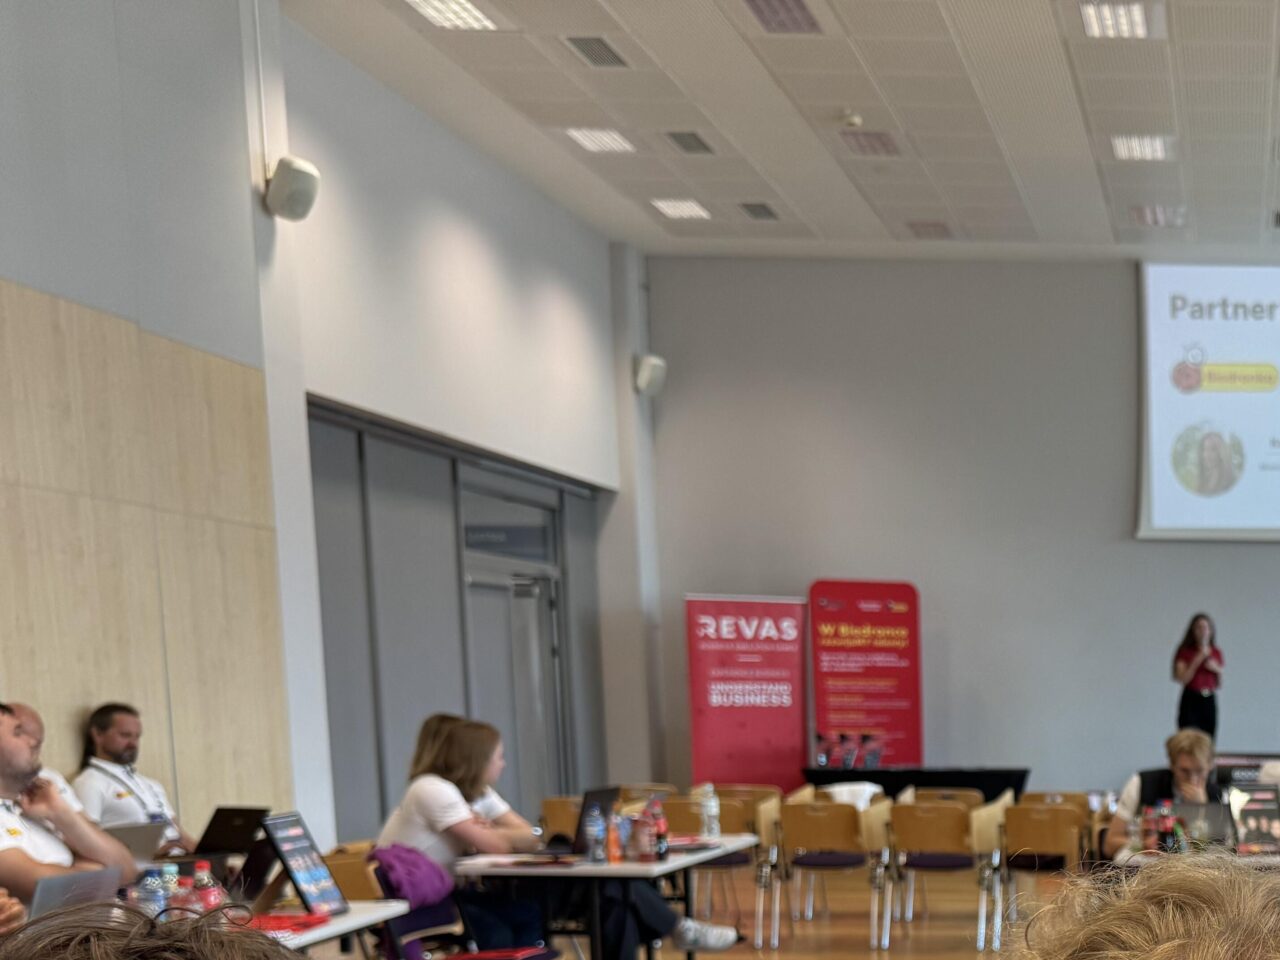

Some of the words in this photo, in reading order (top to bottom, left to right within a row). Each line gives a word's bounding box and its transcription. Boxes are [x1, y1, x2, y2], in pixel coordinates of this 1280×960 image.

[1170, 295, 1278, 321] Partner
[697, 615, 798, 641] REVAS
[709, 693, 793, 707] BUSINESS
